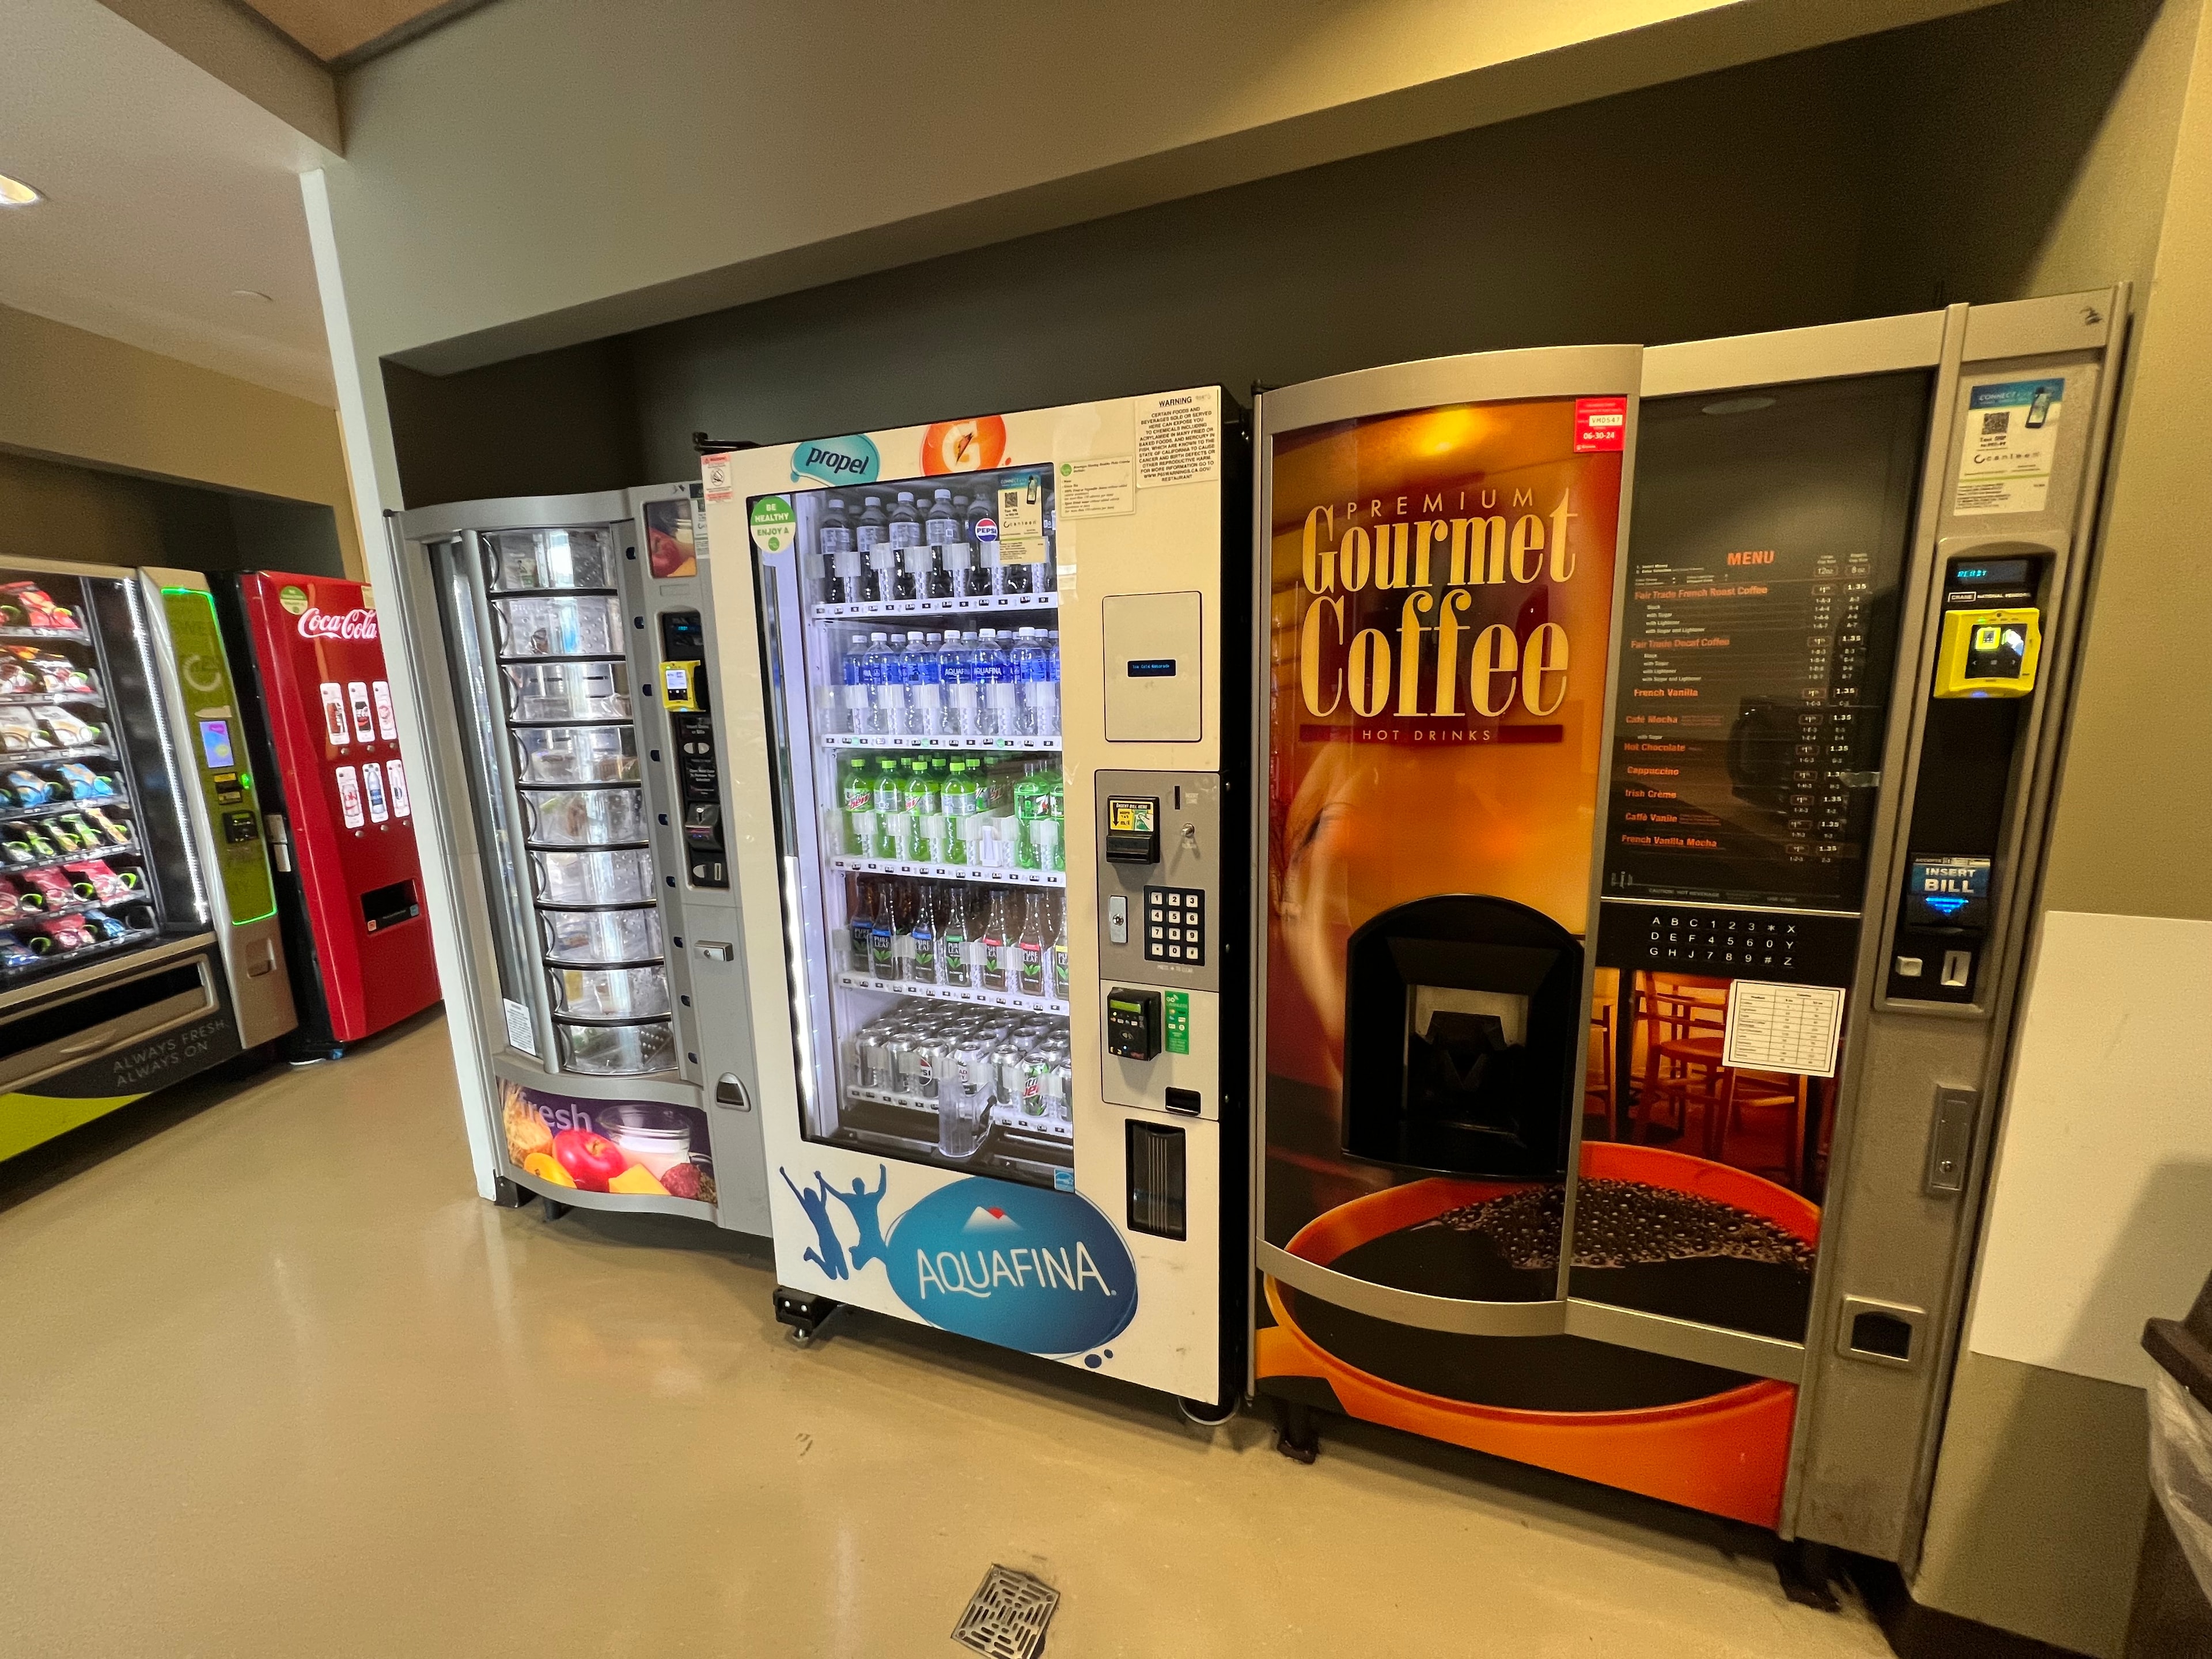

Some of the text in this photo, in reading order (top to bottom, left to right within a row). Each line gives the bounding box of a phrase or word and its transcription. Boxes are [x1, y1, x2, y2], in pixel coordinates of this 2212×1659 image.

[1159, 396, 1192, 407] WARNING
[1584, 431, 1615, 440] 06-30-24
[806, 447, 869, 475] propel
[1160, 457, 1195, 465] REPRODUCTIVE
[766, 503, 776, 512] BE
[1347, 488, 1533, 519] PREMIUM
[755, 513, 789, 522] HEALTHY
[1302, 487, 1578, 594] Gourmet
[1727, 550, 1775, 566] MENU
[1635, 592, 1651, 600] Fair
[1679, 589, 1707, 597] French
[1710, 588, 1736, 596] Roast
[1737, 586, 1768, 594] Coffee
[297, 608, 377, 639] Coca-Cola
[1675, 639, 1699, 647] Decaf
[1701, 638, 1730, 646] Coffee
[1301, 589, 1569, 717] Coffee
[974, 668, 1002, 676] AQUAFINA
[1668, 688, 1698, 696] Vanilla
[1648, 715, 1677, 724] Mocha
[1362, 729, 1491, 741] HOT DRINKS
[1627, 766, 1679, 775] Cappuccino
[1626, 789, 1645, 797] Irish
[1622, 835, 1651, 843] French
[1654, 836, 1683, 846] Vanilla
[1687, 838, 1717, 847] Mocha
[1926, 868, 1976, 877] INSERT
[1925, 879, 1974, 893] BILL
[1671, 918, 1679, 926] B
[1729, 922, 1736, 930] 2
[1748, 923, 1755, 931] 3
[1787, 925, 1796, 933] X
[1652, 932, 1659, 940] D
[1670, 933, 1677, 941] E
[1728, 937, 1733, 945] 5
[1747, 938, 1753, 946] 6
[1650, 948, 1658, 956] G
[1668, 949, 1676, 957] H
[1726, 953, 1732, 961] 8
[1745, 954, 1752, 962] 9
[1784, 957, 1792, 965] Z
[113, 1039, 176, 1073] ALWAYS
[117, 1041, 208, 1087] ALWAYS ON
[520, 1092, 592, 1132] fresh
[917, 1241, 1111, 1299] AQUAFINA
